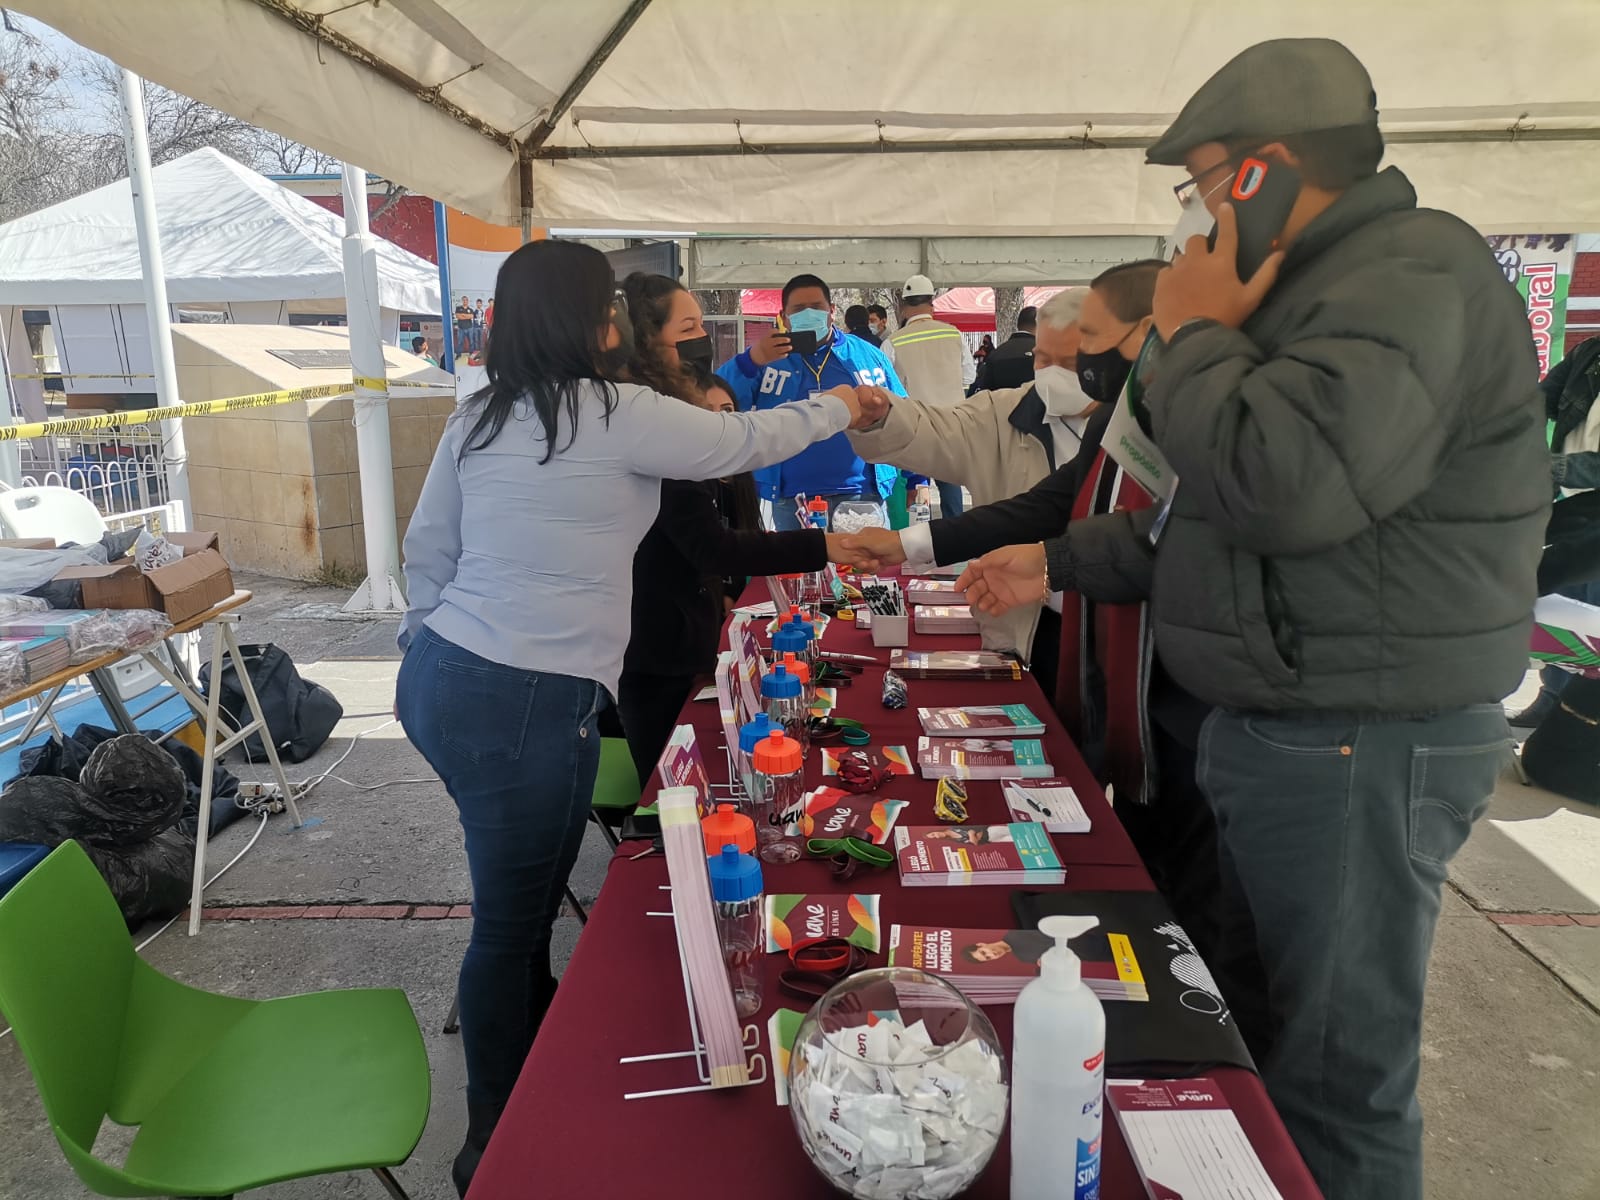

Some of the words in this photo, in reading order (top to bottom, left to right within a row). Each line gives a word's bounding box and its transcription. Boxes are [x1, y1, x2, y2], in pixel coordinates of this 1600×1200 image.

[1524, 263, 1557, 383] boral
[760, 366, 791, 396] BT
[145, 408, 183, 423] PROHIBIDO
[184, 405, 193, 417] EL
[194, 402, 212, 416] PASO
[225, 396, 256, 411] PROHIBIDO
[256, 396, 263, 408] EL
[263, 393, 278, 406] PASO
[42, 418, 91, 435] PROHIBIDO
[93, 416, 104, 429] EL
[106, 413, 128, 426] PASO
[768, 810, 805, 827] uan
[831, 929, 840, 937] EN
[925, 931, 939, 943] EL
[923, 942, 939, 969] LLEGÓ
[940, 929, 952, 972] MOMENTO
